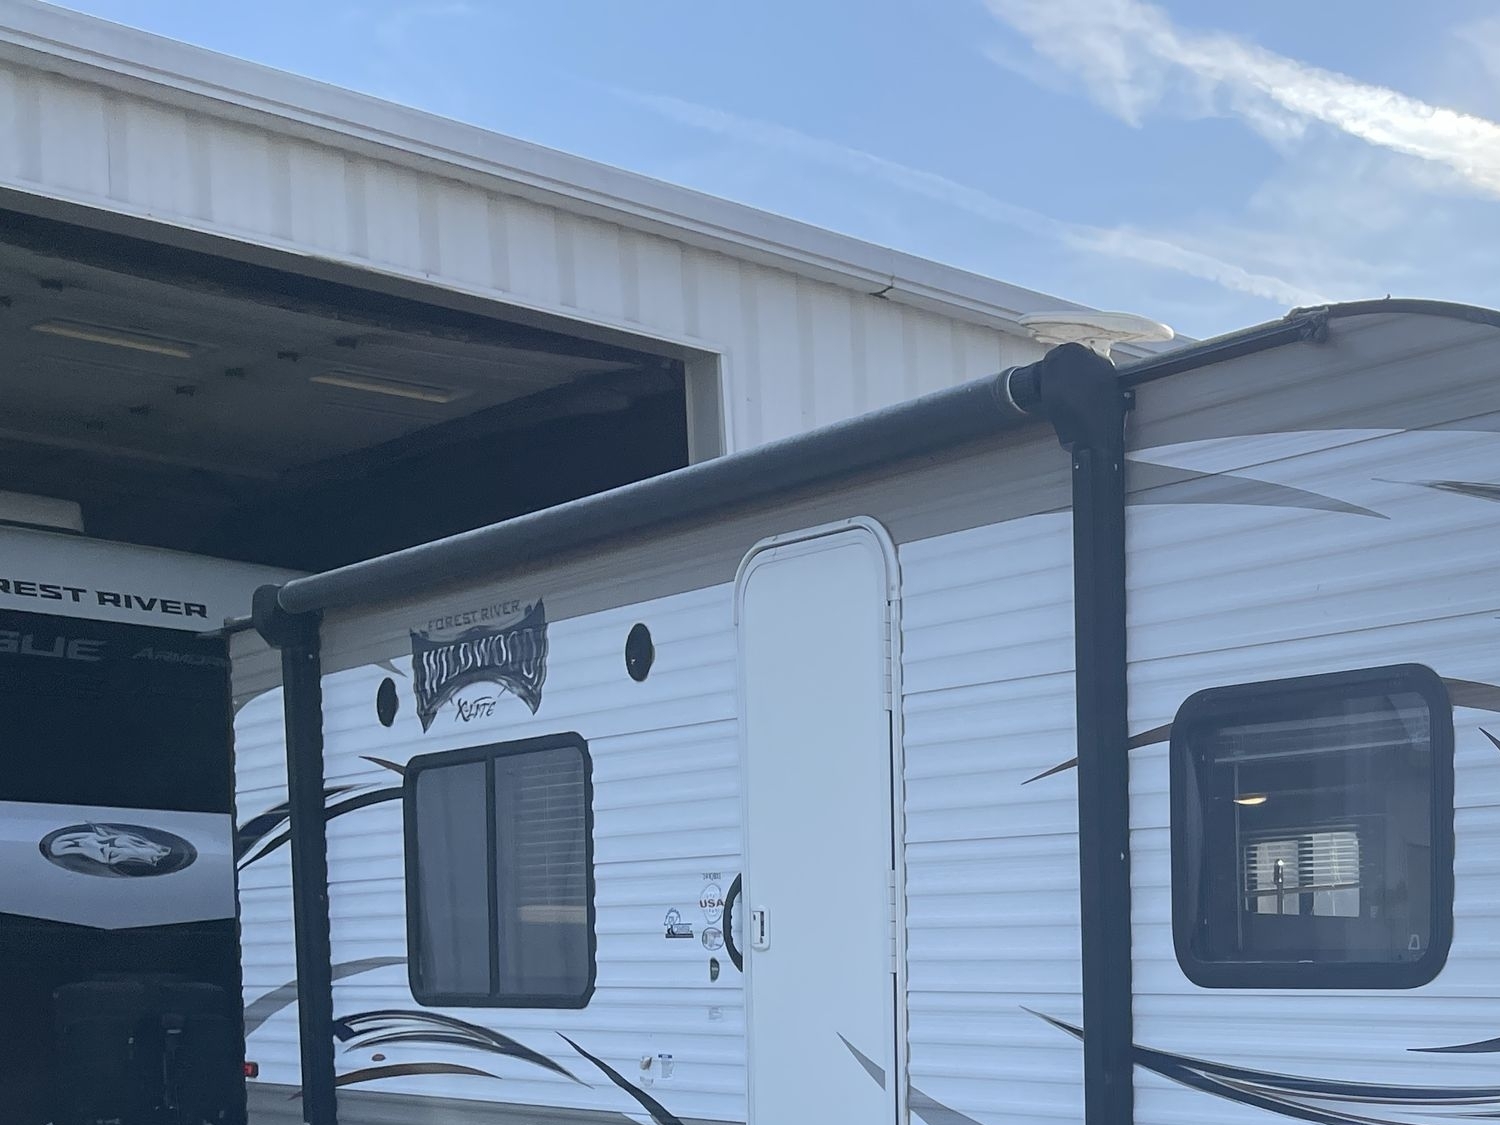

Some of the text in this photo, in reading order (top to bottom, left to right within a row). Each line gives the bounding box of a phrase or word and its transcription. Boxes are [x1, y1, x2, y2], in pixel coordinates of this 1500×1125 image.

[95, 590, 208, 619] RIVER
[427, 599, 522, 632] FOREST RIVER
[699, 898, 725, 909] USA
